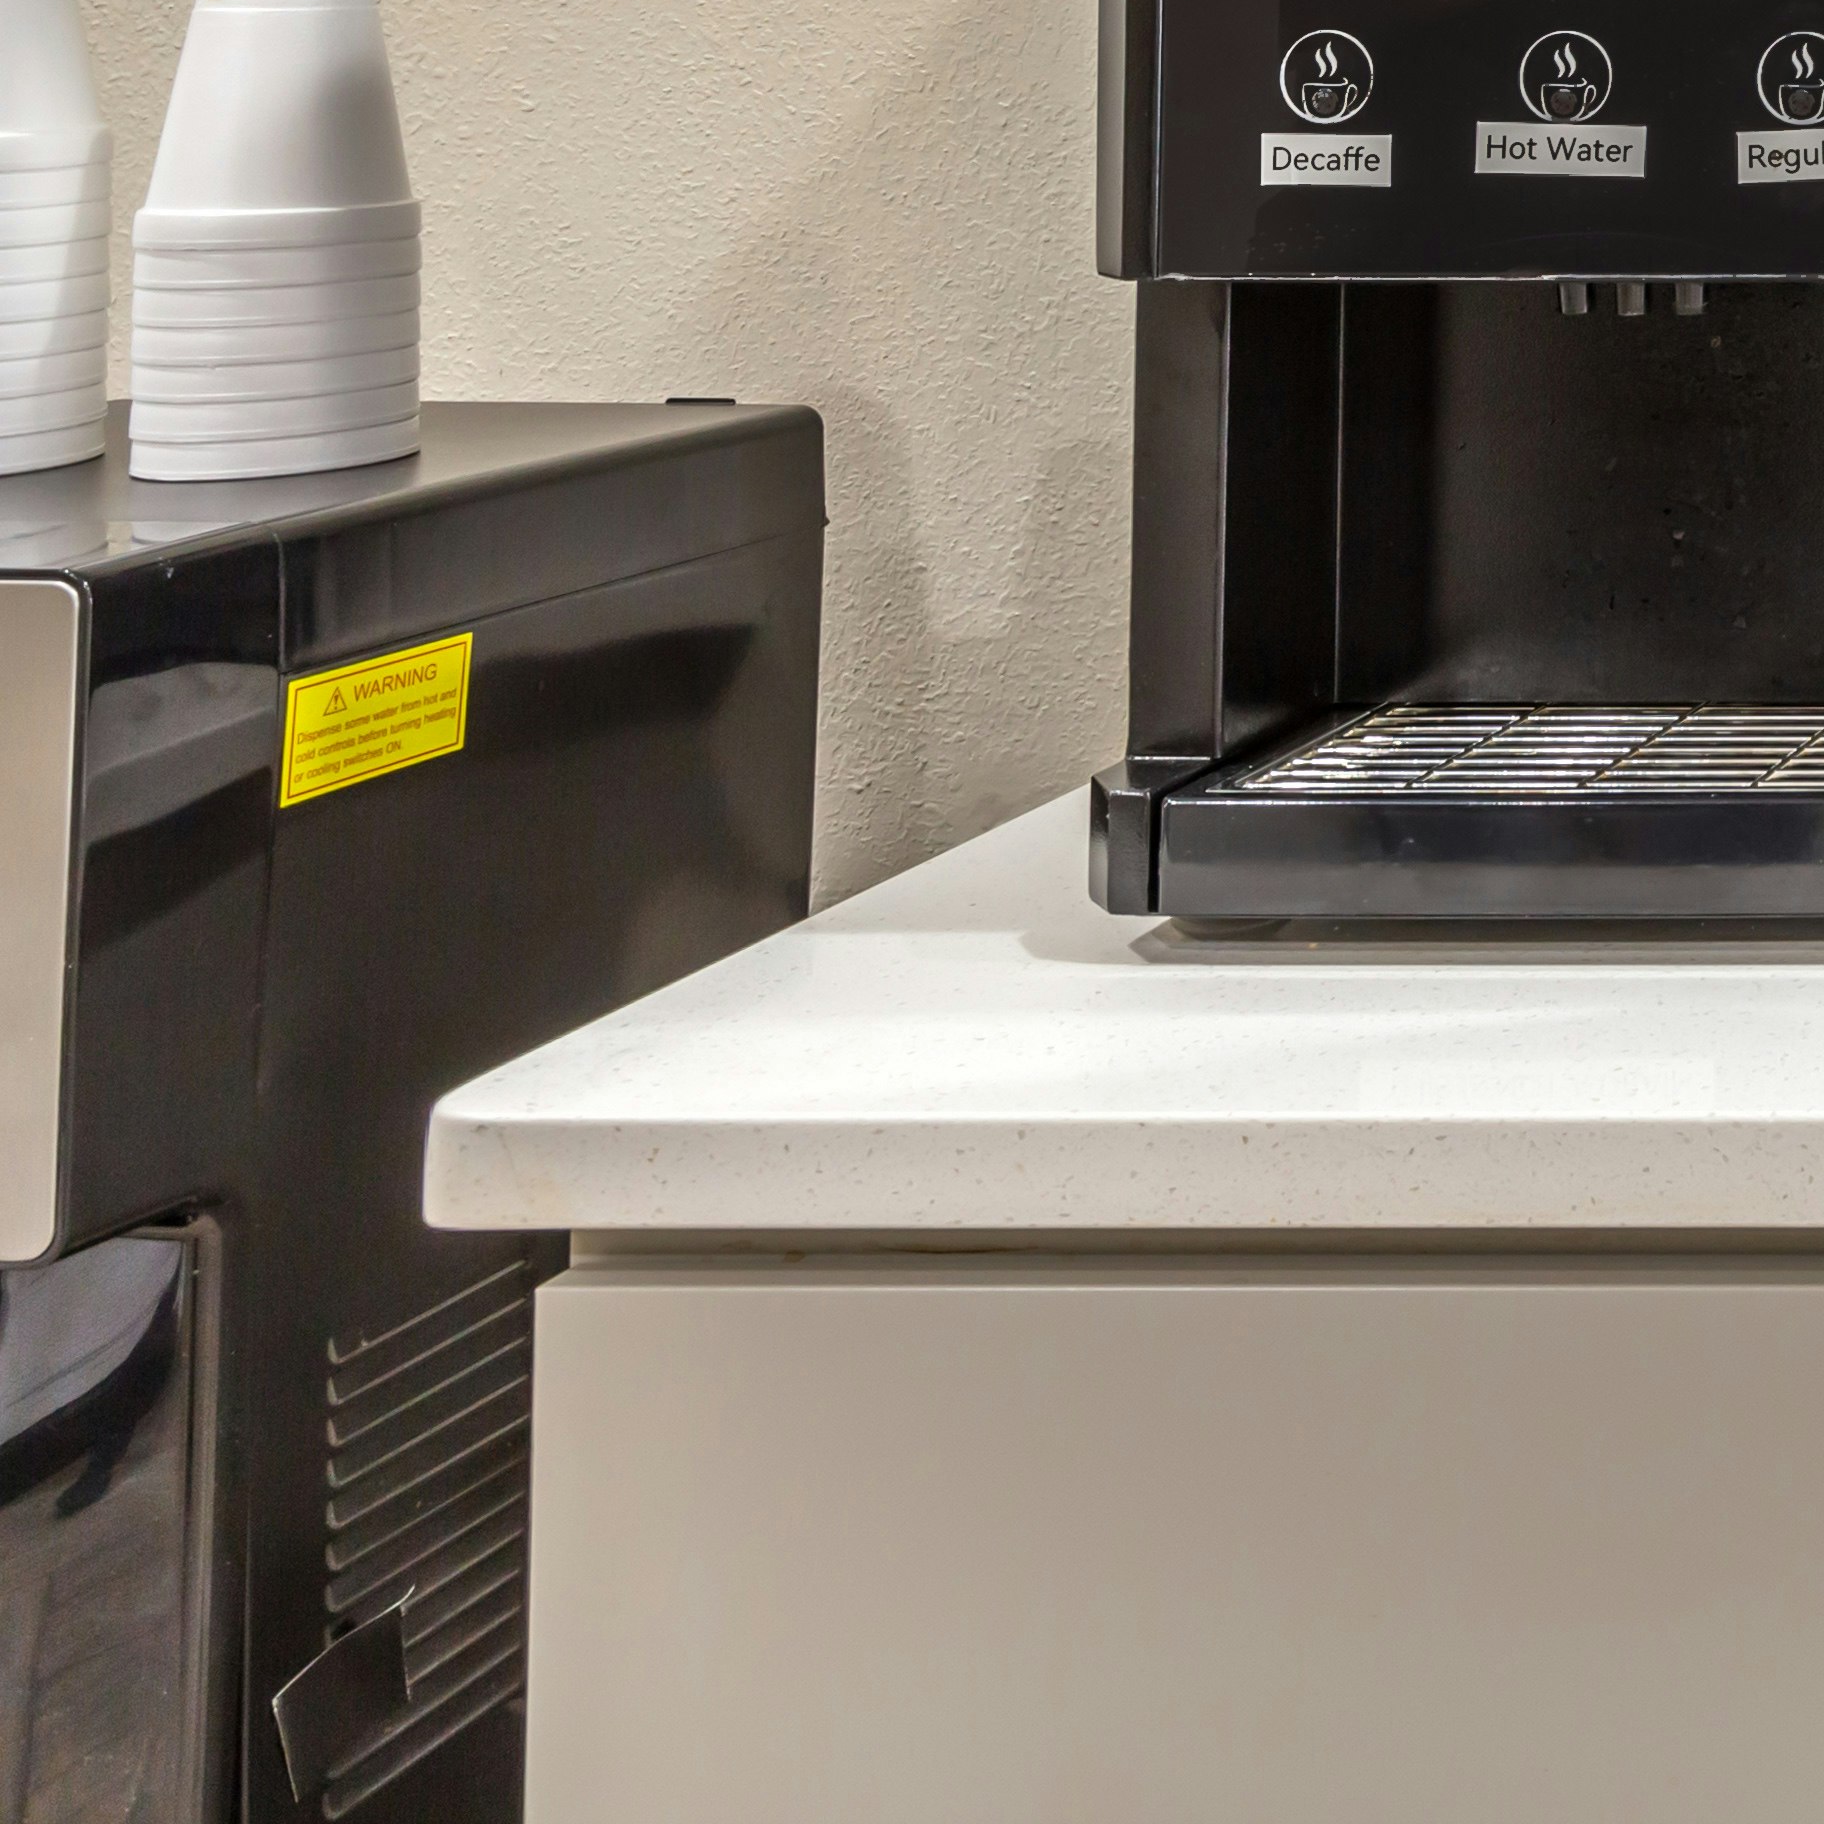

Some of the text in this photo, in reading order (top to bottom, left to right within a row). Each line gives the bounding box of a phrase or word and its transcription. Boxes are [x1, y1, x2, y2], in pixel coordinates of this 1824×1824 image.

[1271, 145, 1381, 173] Decaffe
[1486, 135, 1634, 165] Hot Water
[353, 663, 438, 702] WARNING
[295, 706, 457, 764] cold controls before turning heating
[297, 687, 457, 745] Dispense some water from hot and
[293, 773, 305, 784] or
[306, 759, 341, 780] cooling
[343, 746, 384, 768] switches
